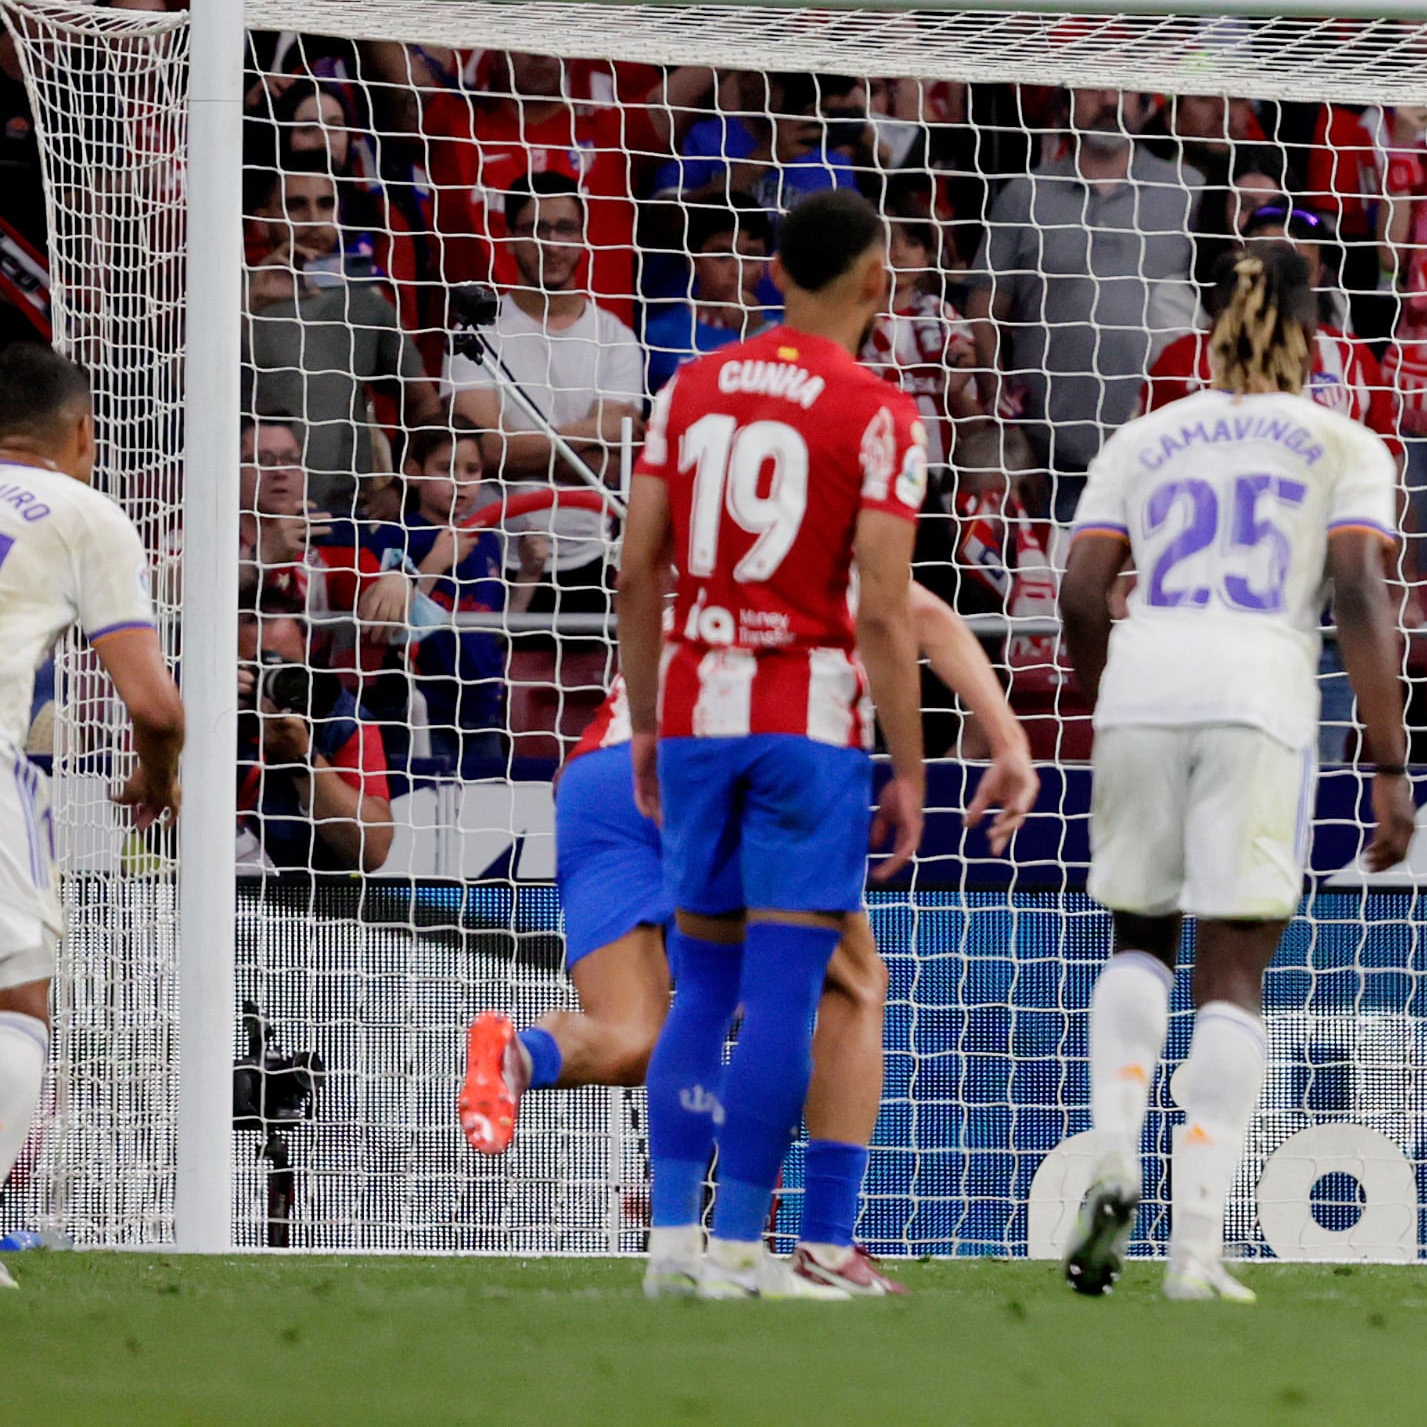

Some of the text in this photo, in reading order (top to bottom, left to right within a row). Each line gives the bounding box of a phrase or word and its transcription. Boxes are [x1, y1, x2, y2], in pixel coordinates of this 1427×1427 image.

[718, 359, 826, 410] CUNHA
[1138, 416, 1326, 471] CAMAVINGA
[0, 483, 51, 523] IRO
[677, 412, 810, 582] 19
[1143, 473, 1309, 613] 25
